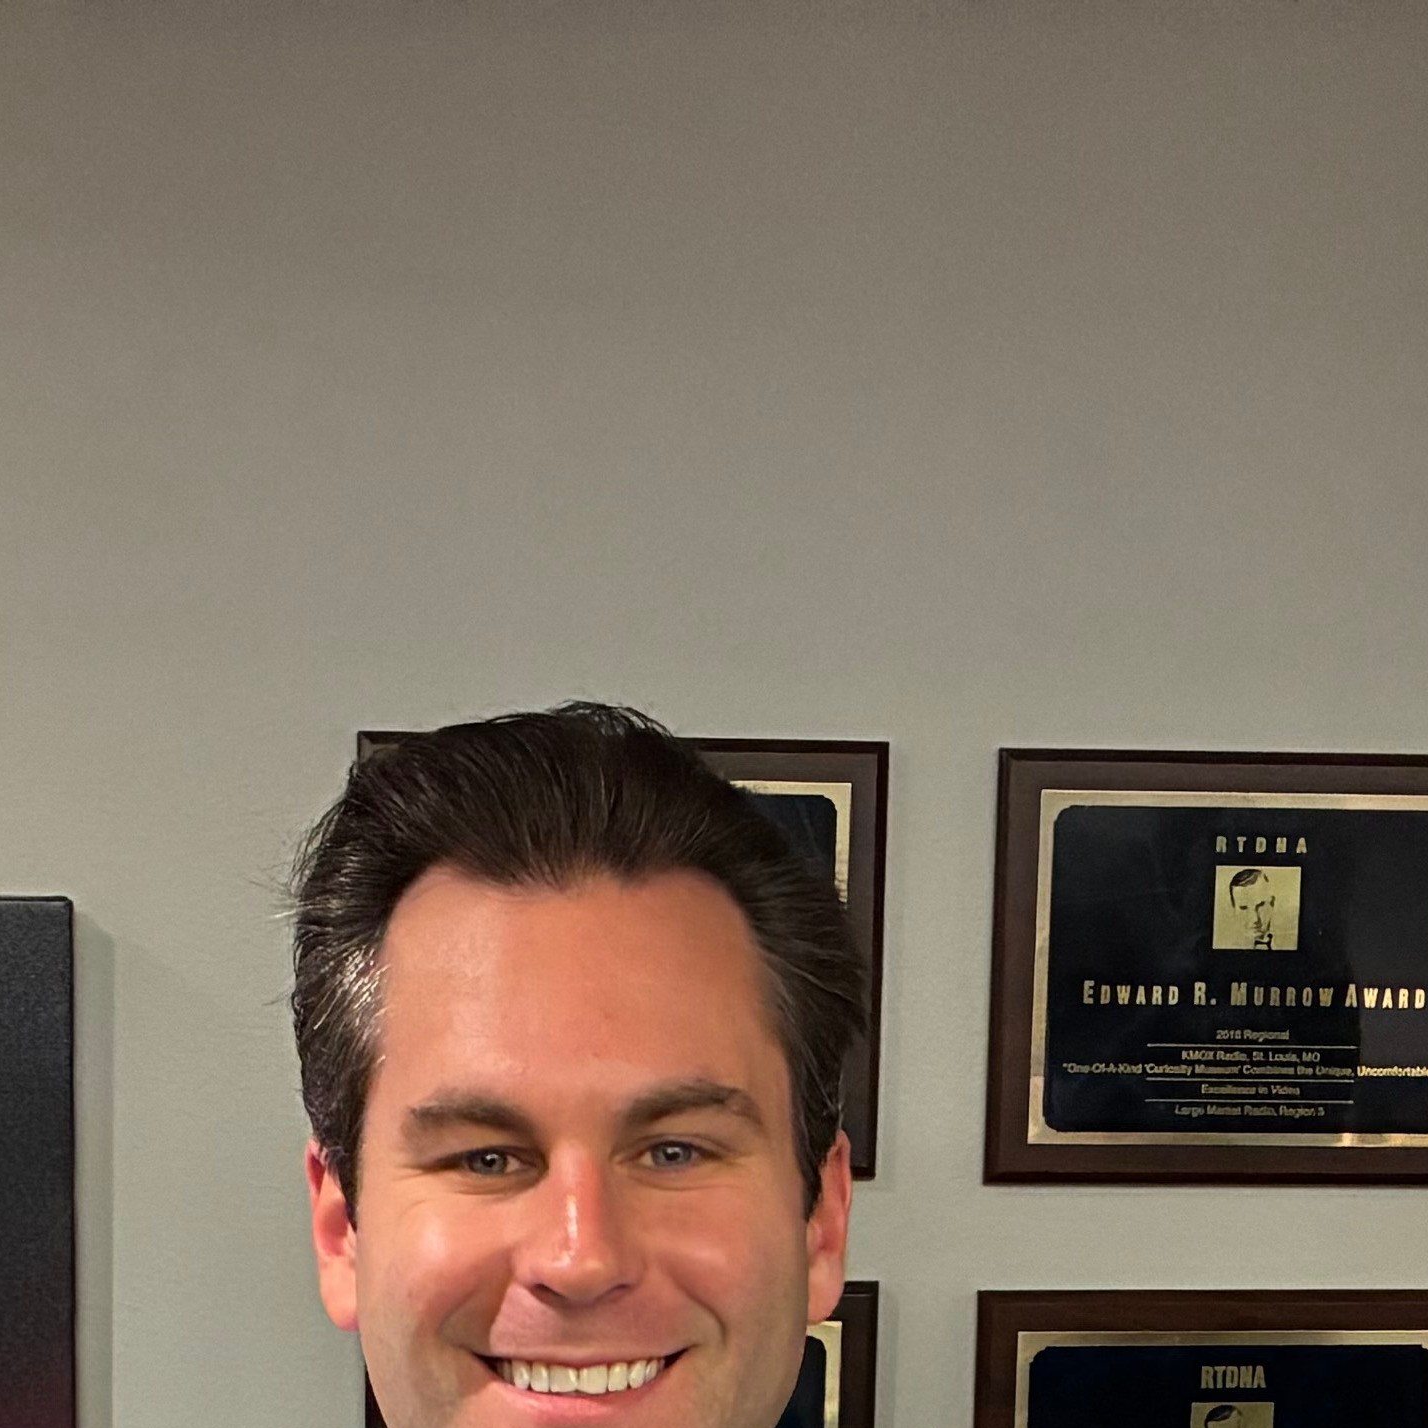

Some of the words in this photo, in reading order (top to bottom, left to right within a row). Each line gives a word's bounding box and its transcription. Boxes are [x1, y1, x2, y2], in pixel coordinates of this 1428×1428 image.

[1216, 836, 1308, 853] RTDNA
[1193, 982, 1217, 1006] R.
[1200, 1365, 1266, 1389] RTDNA
